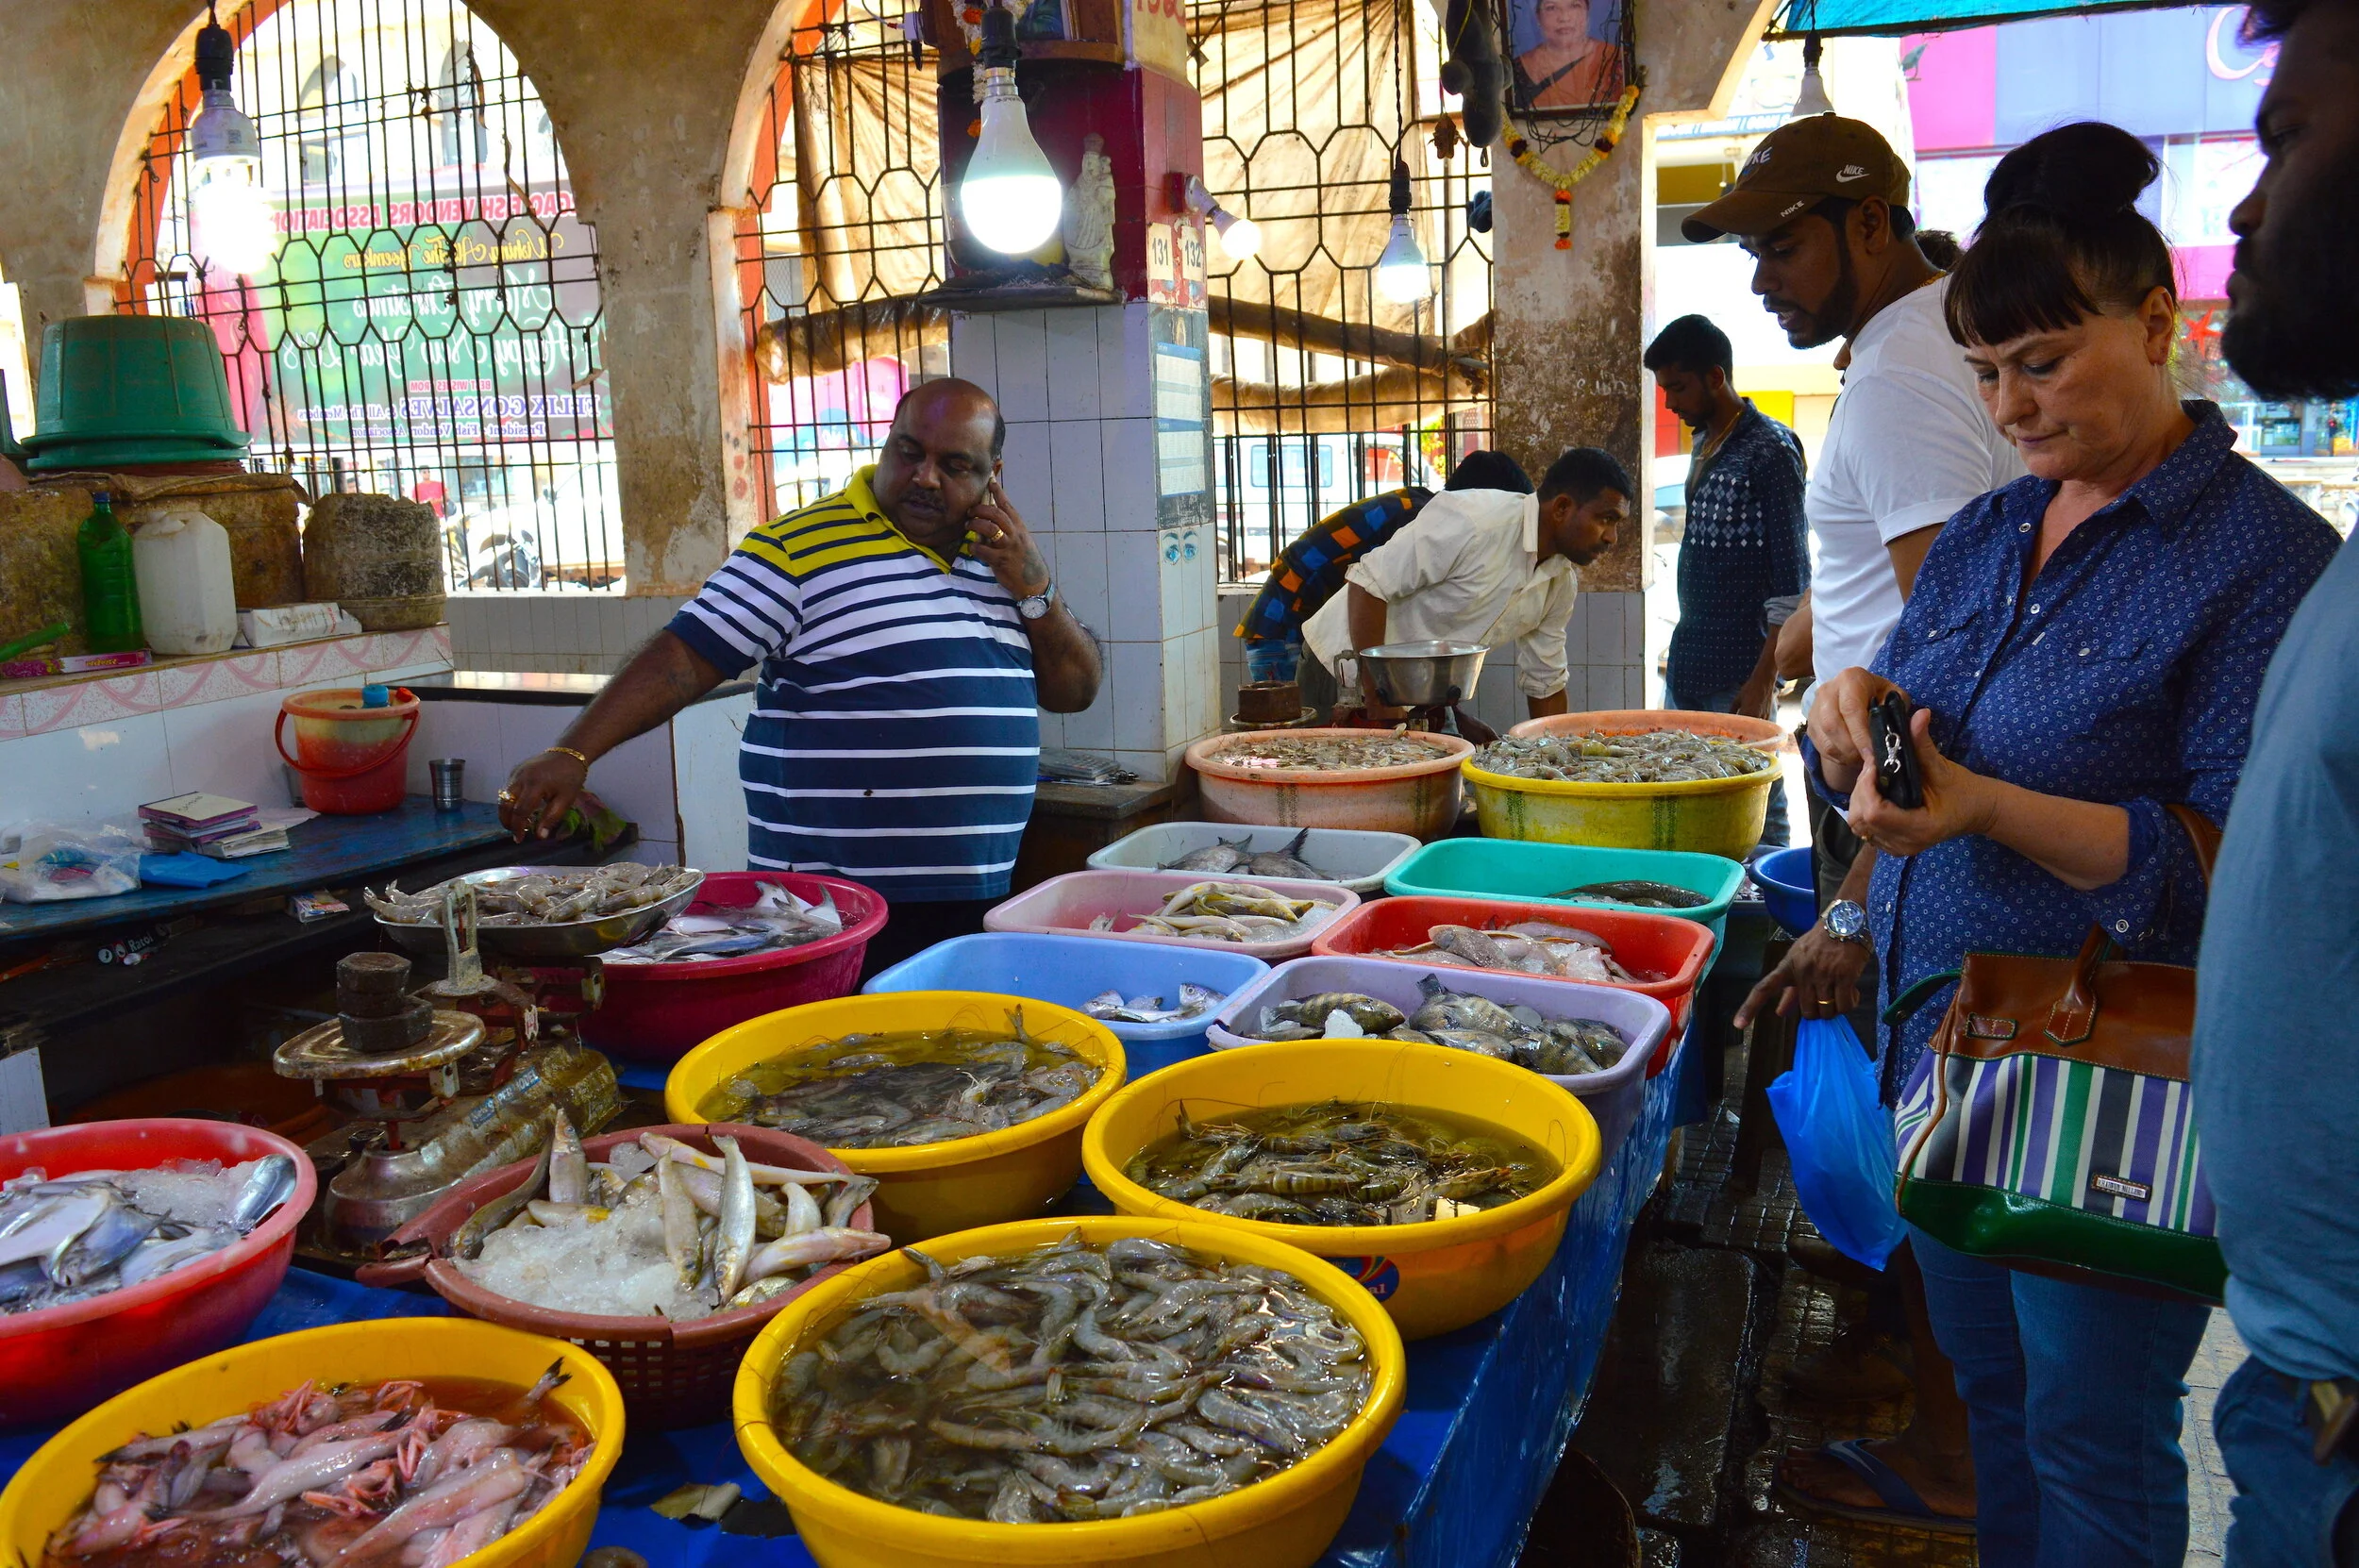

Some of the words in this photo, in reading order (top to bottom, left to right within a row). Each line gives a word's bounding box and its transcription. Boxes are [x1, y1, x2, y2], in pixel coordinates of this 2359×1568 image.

[1843, 164, 1865, 175] NIKE
[1781, 200, 1804, 218] NIKE
[1152, 237, 1169, 265] 131
[1185, 240, 1201, 268] 132
